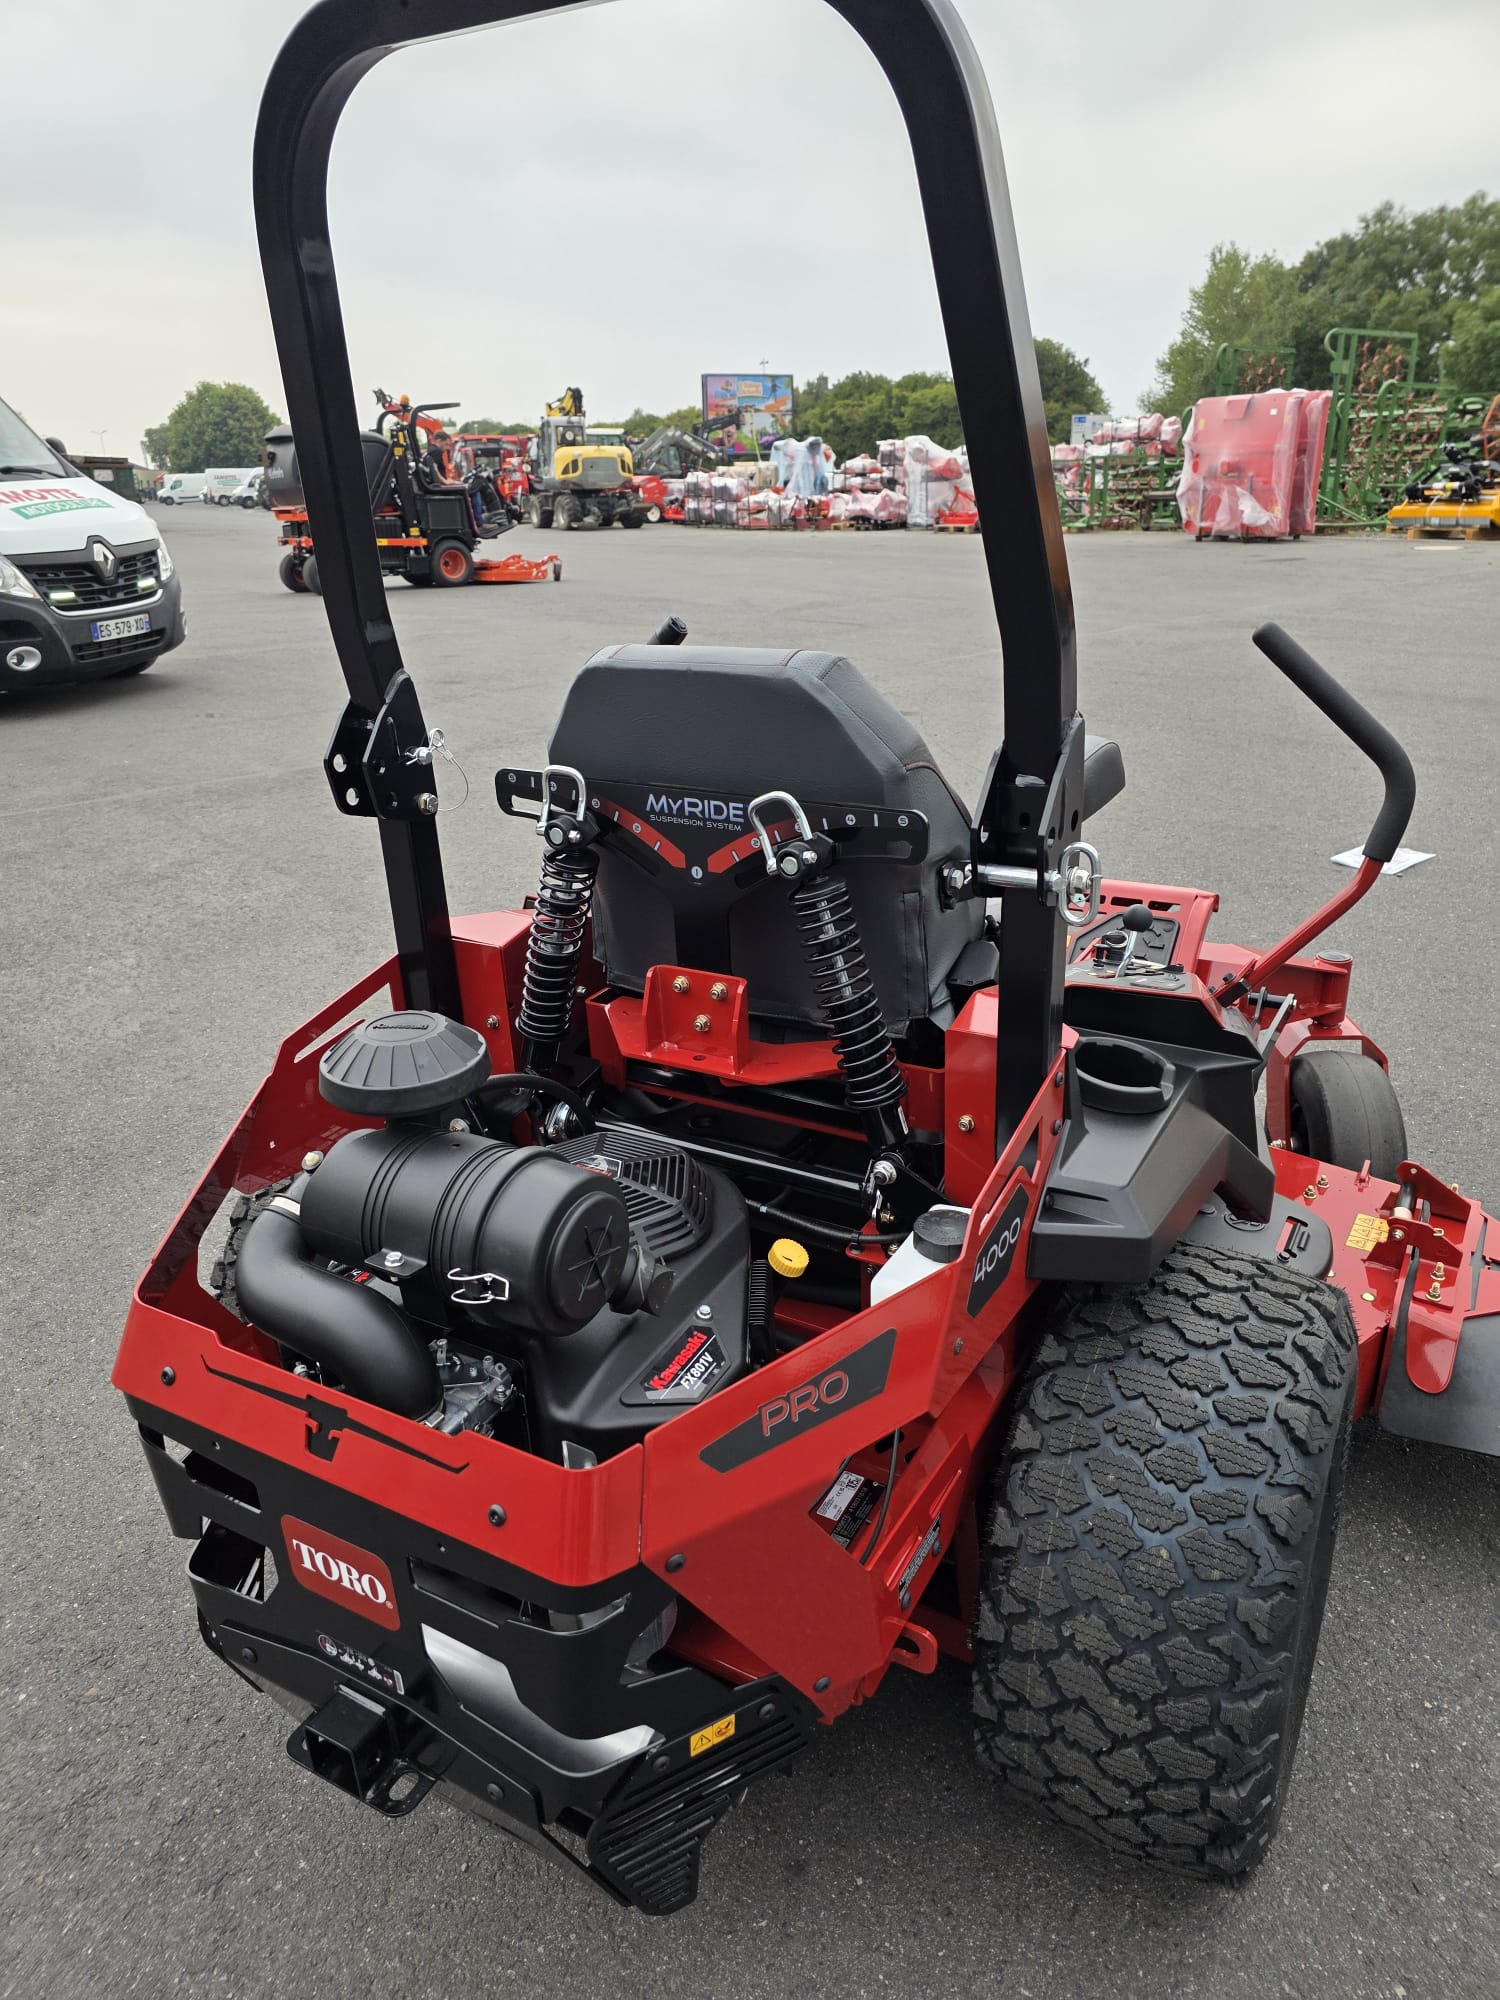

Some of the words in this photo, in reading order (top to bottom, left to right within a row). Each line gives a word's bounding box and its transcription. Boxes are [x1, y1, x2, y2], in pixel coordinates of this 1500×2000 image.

[650, 814, 703, 827] SUSPENSION
[707, 821, 742, 832] SYSTEM
[974, 1217, 1021, 1283] 4000
[649, 1330, 707, 1391] Kawasaki
[680, 1351, 714, 1390] FX801V
[761, 1370, 849, 1436] PRO
[292, 1538, 387, 1604] TORO
